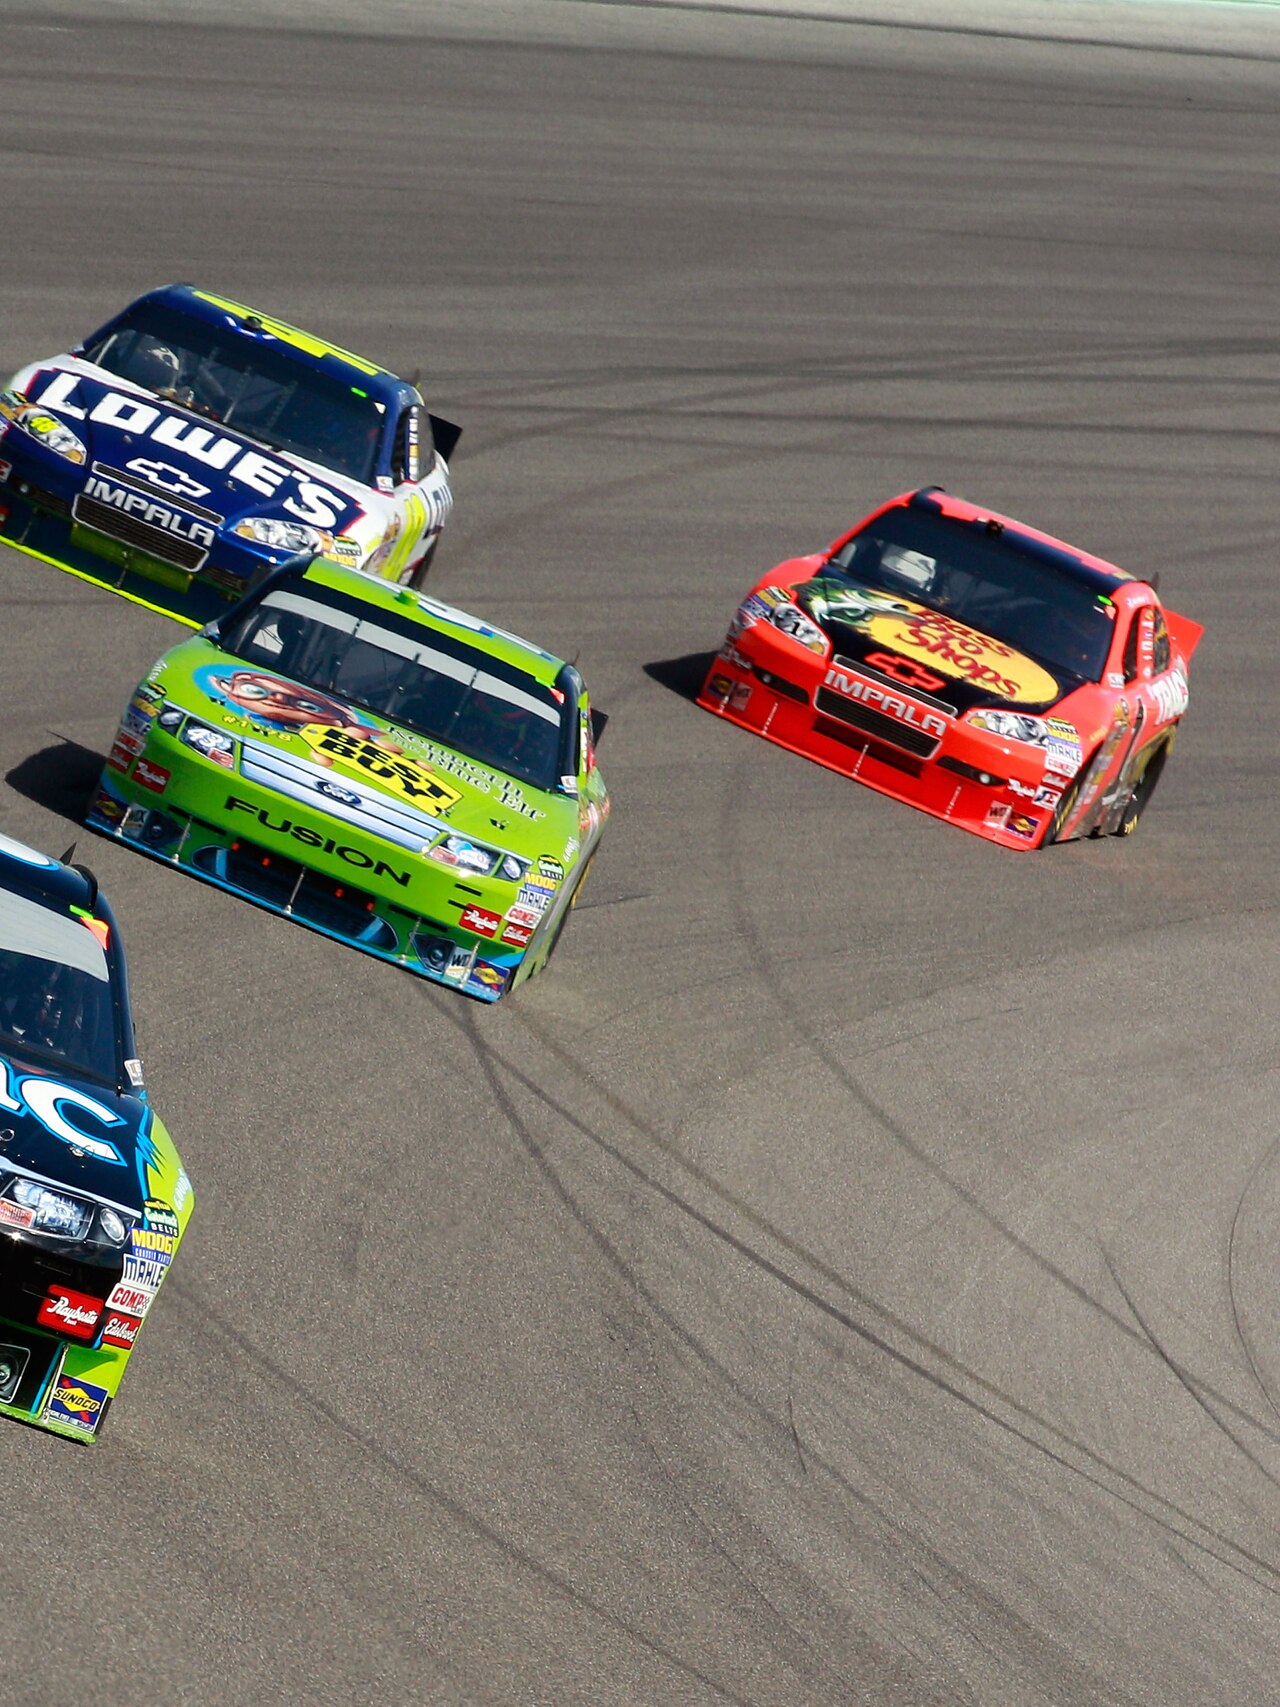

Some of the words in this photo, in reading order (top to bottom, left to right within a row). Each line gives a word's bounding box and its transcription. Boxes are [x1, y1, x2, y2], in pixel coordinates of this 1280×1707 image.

[36, 371, 346, 529] LOWE'S
[84, 475, 216, 548] IMPALA
[907, 617, 984, 657] Pro
[919, 609, 1014, 659] Bass
[895, 627, 1022, 697] Shops
[824, 669, 948, 738] IMPALA
[319, 738, 435, 800] BUY
[324, 729, 455, 804] BEST
[386, 726, 525, 801] Kenneth
[1047, 740, 1082, 764] MAHLE
[425, 750, 491, 795] Blue
[224, 795, 413, 887] FUSION
[519, 889, 551, 910] MAHLE
[524, 872, 557, 891] MOOG
[131, 1227, 174, 1255] MOOG
[150, 1221, 179, 1238] BELTS
[125, 1256, 166, 1288] MAHLE
[46, 1296, 99, 1327] Raybestos
[111, 1286, 145, 1309] COMP
[104, 1317, 138, 1343] Edelbrock
[53, 1387, 100, 1411] SUNOCO
